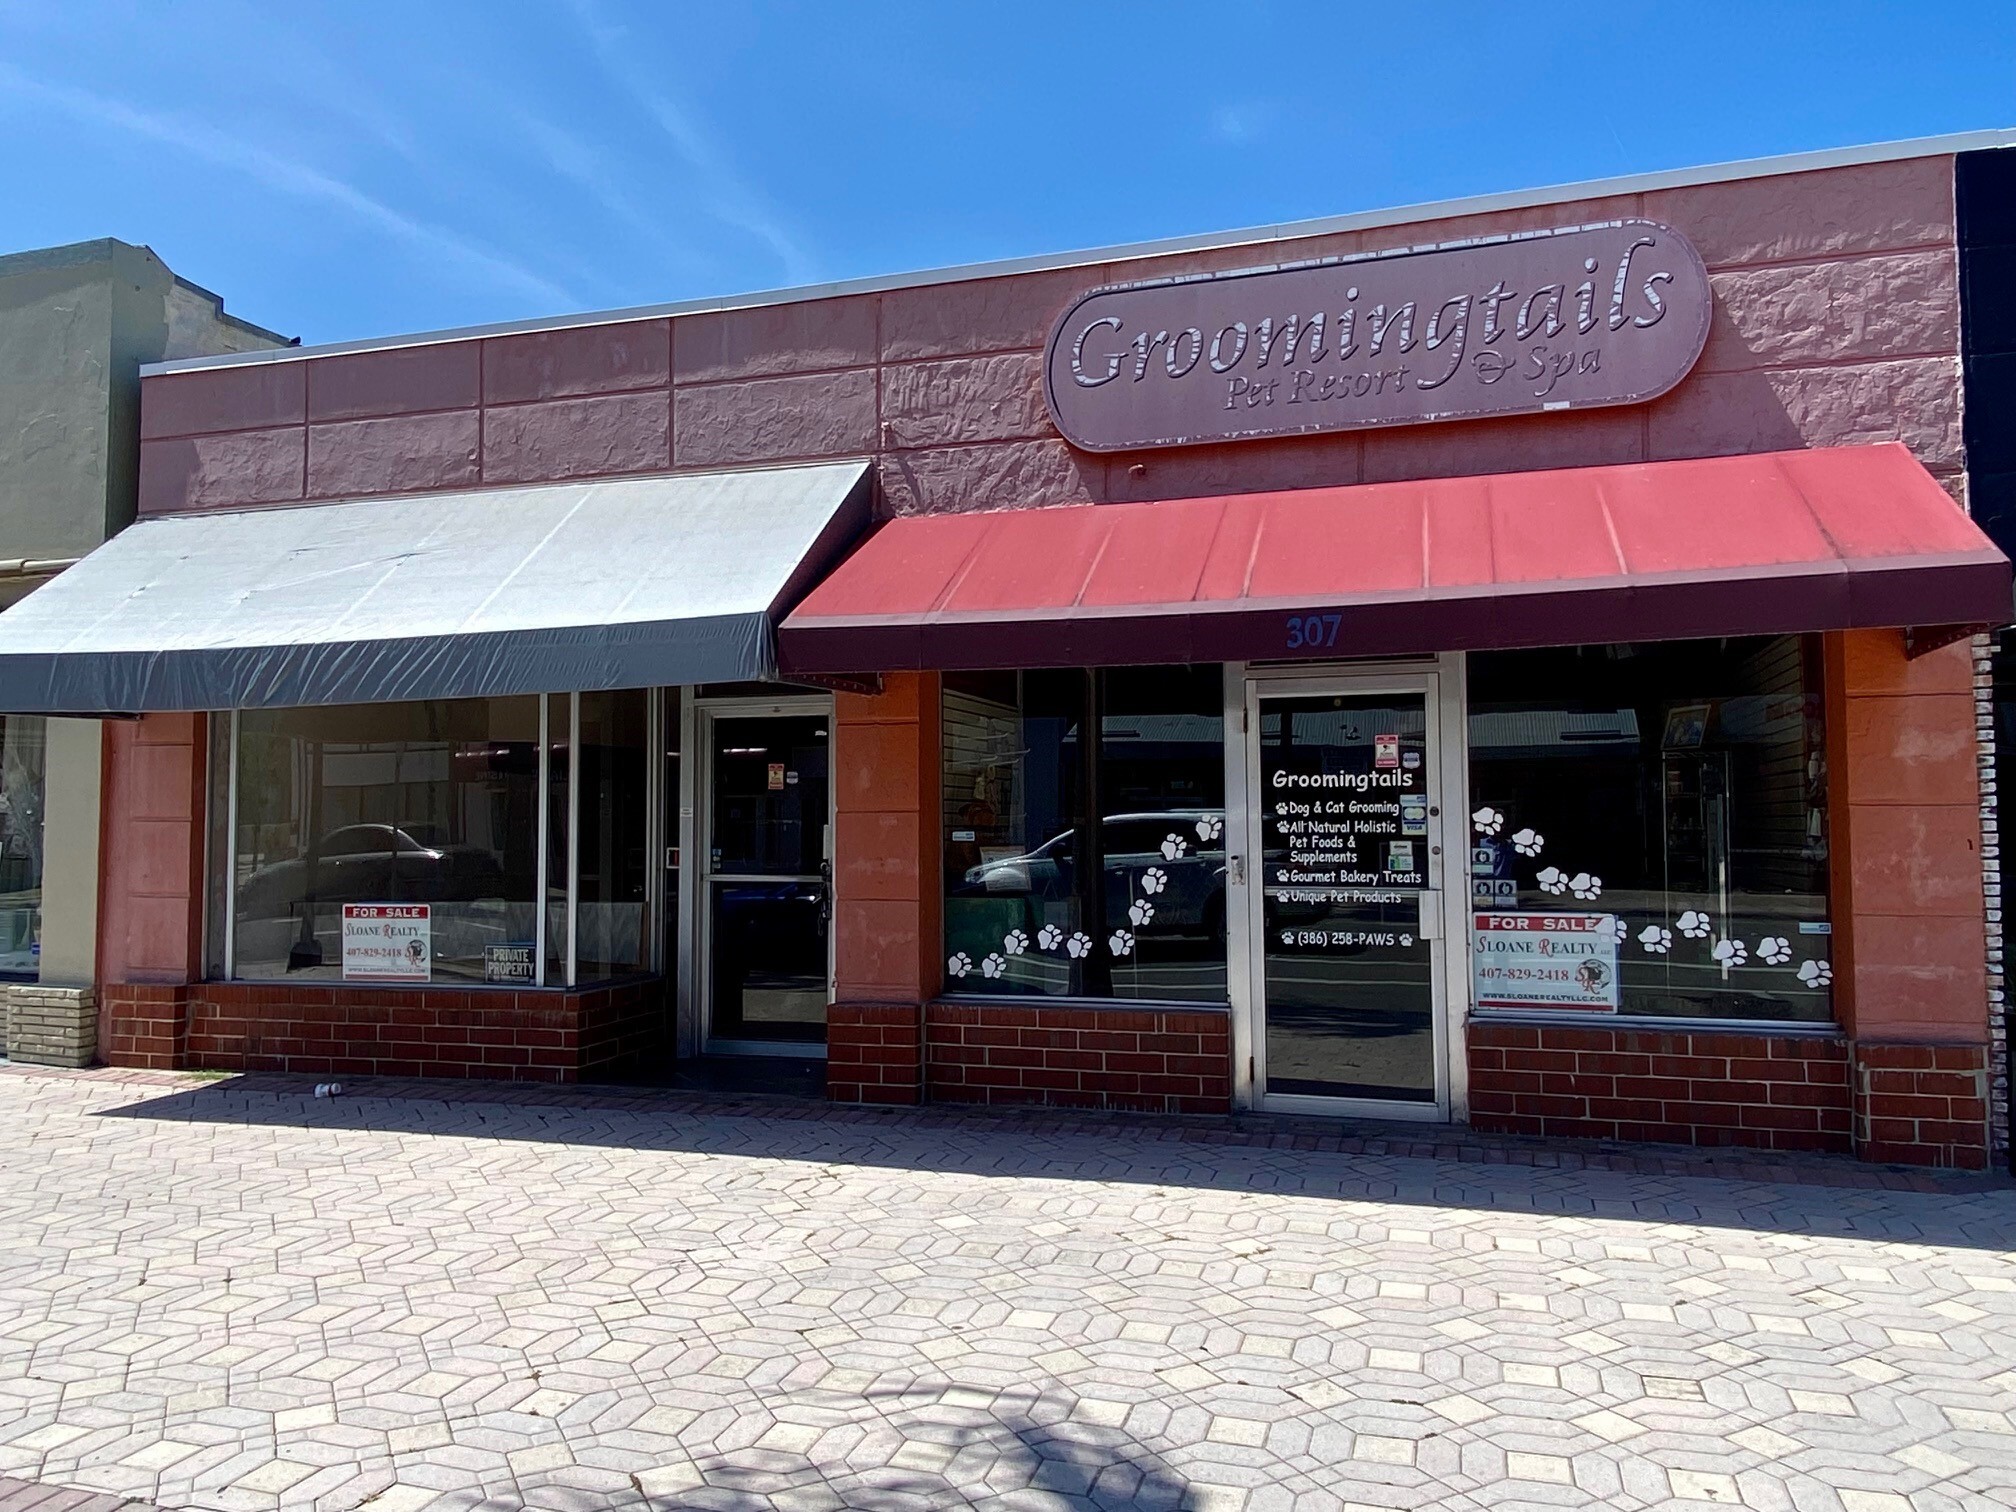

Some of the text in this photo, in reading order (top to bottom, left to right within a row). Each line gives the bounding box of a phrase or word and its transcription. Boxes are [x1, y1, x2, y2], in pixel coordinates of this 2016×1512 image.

[1071, 237, 1674, 389] Groomingtails
[1223, 345, 1602, 410] Pet Resort & Spa
[1286, 614, 1343, 649] 307
[1272, 768, 1414, 792] Groomingtails
[1289, 800, 1400, 817] Dog & Cat Grooming
[1308, 820, 1350, 833] Natural
[1354, 820, 1397, 833] Holistic
[1290, 835, 1356, 848] Pet Foods &
[1290, 850, 1358, 866] Supplements
[1290, 870, 1422, 886] Gourmet Bakery Treats
[1290, 890, 1402, 905] Unique Pet Products
[352, 907, 421, 918] FOR SALE
[344, 923, 420, 940] SLOANE REALTY
[1489, 917, 1597, 931] FOR SALE
[1297, 931, 1395, 947] (386) 258-PAWS
[1476, 936, 1534, 954] SLOANE
[1538, 938, 1598, 958] REALTY
[346, 947, 402, 958] 407-829-2418
[493, 948, 529, 962] PRIVATE
[488, 961, 535, 976] PROPERTY
[1479, 967, 1570, 981] 407-829-2418
